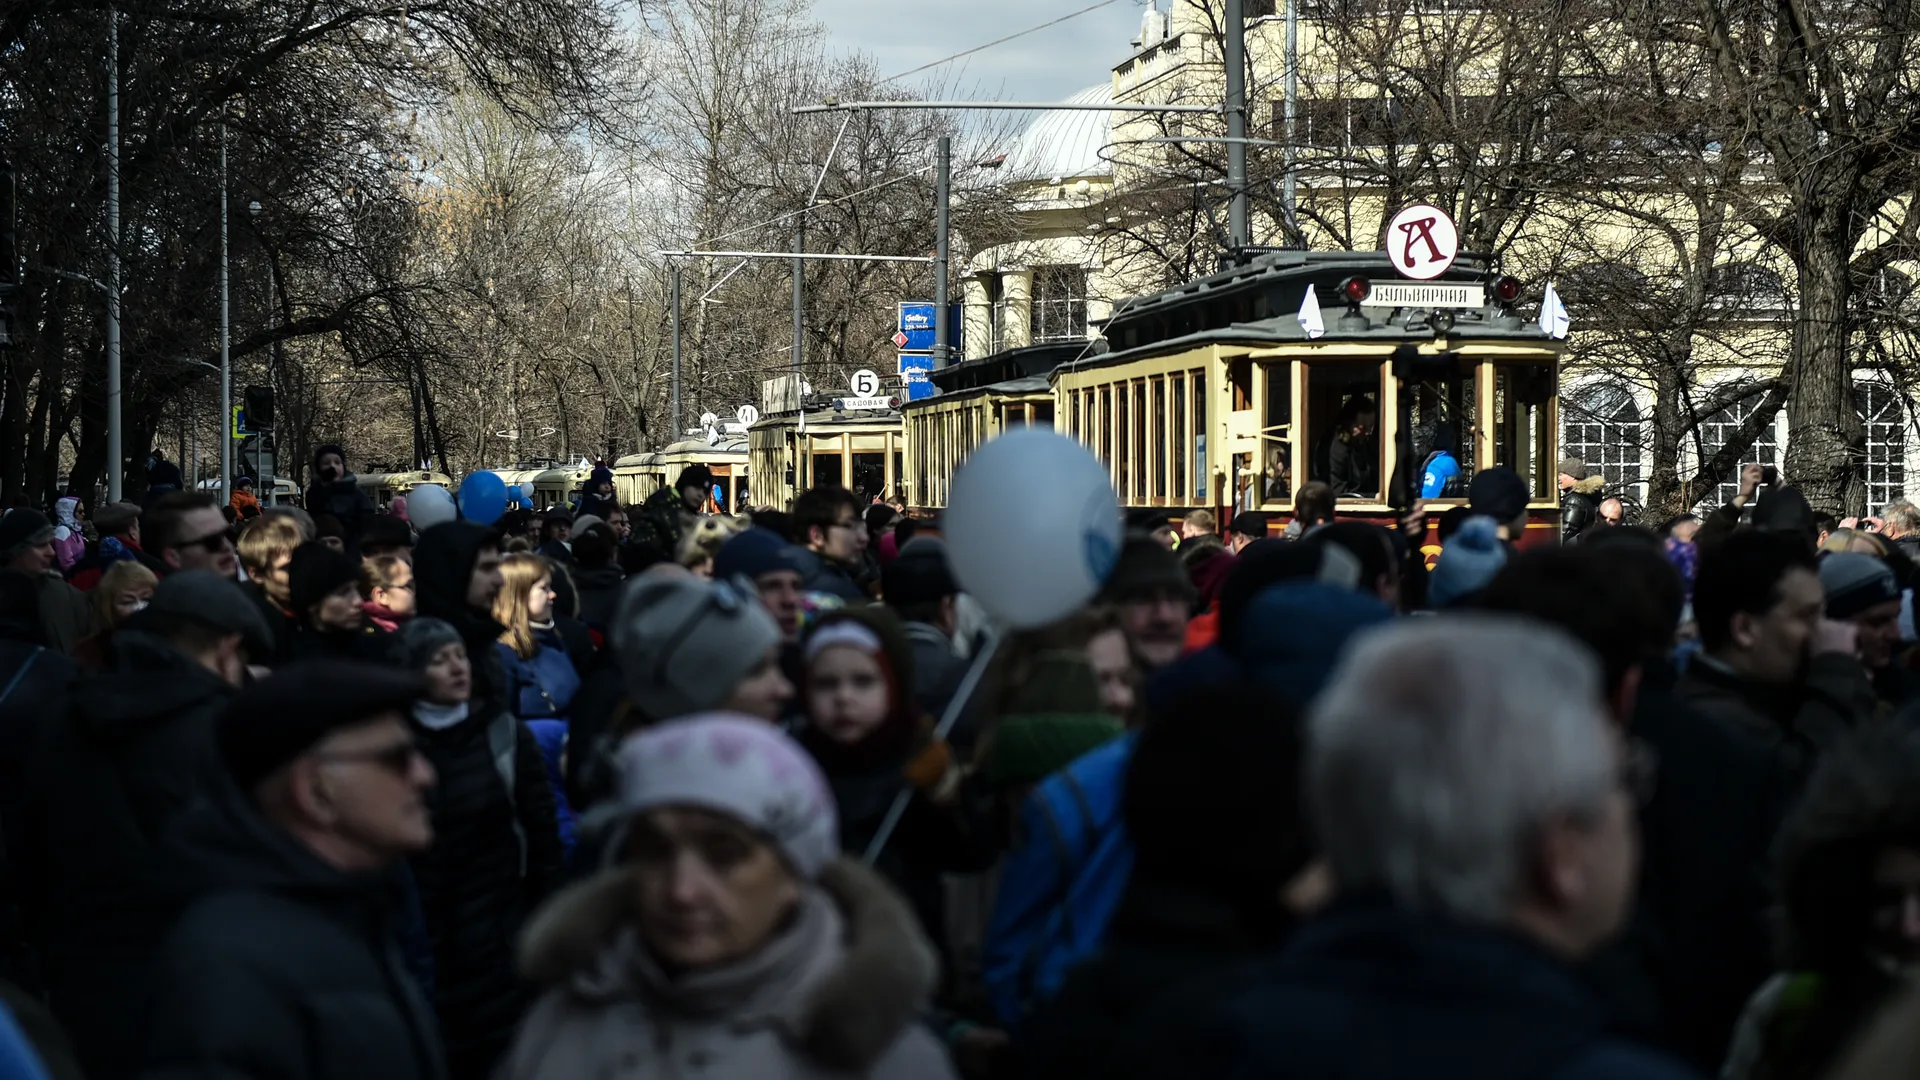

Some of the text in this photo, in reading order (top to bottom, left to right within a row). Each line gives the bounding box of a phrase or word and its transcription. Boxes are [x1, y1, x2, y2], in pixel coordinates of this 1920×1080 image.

[1398, 217, 1448, 268] А
[1375, 287, 1467, 303] БУЛЬВАРНАЯ
[857, 374, 872, 393] Б
